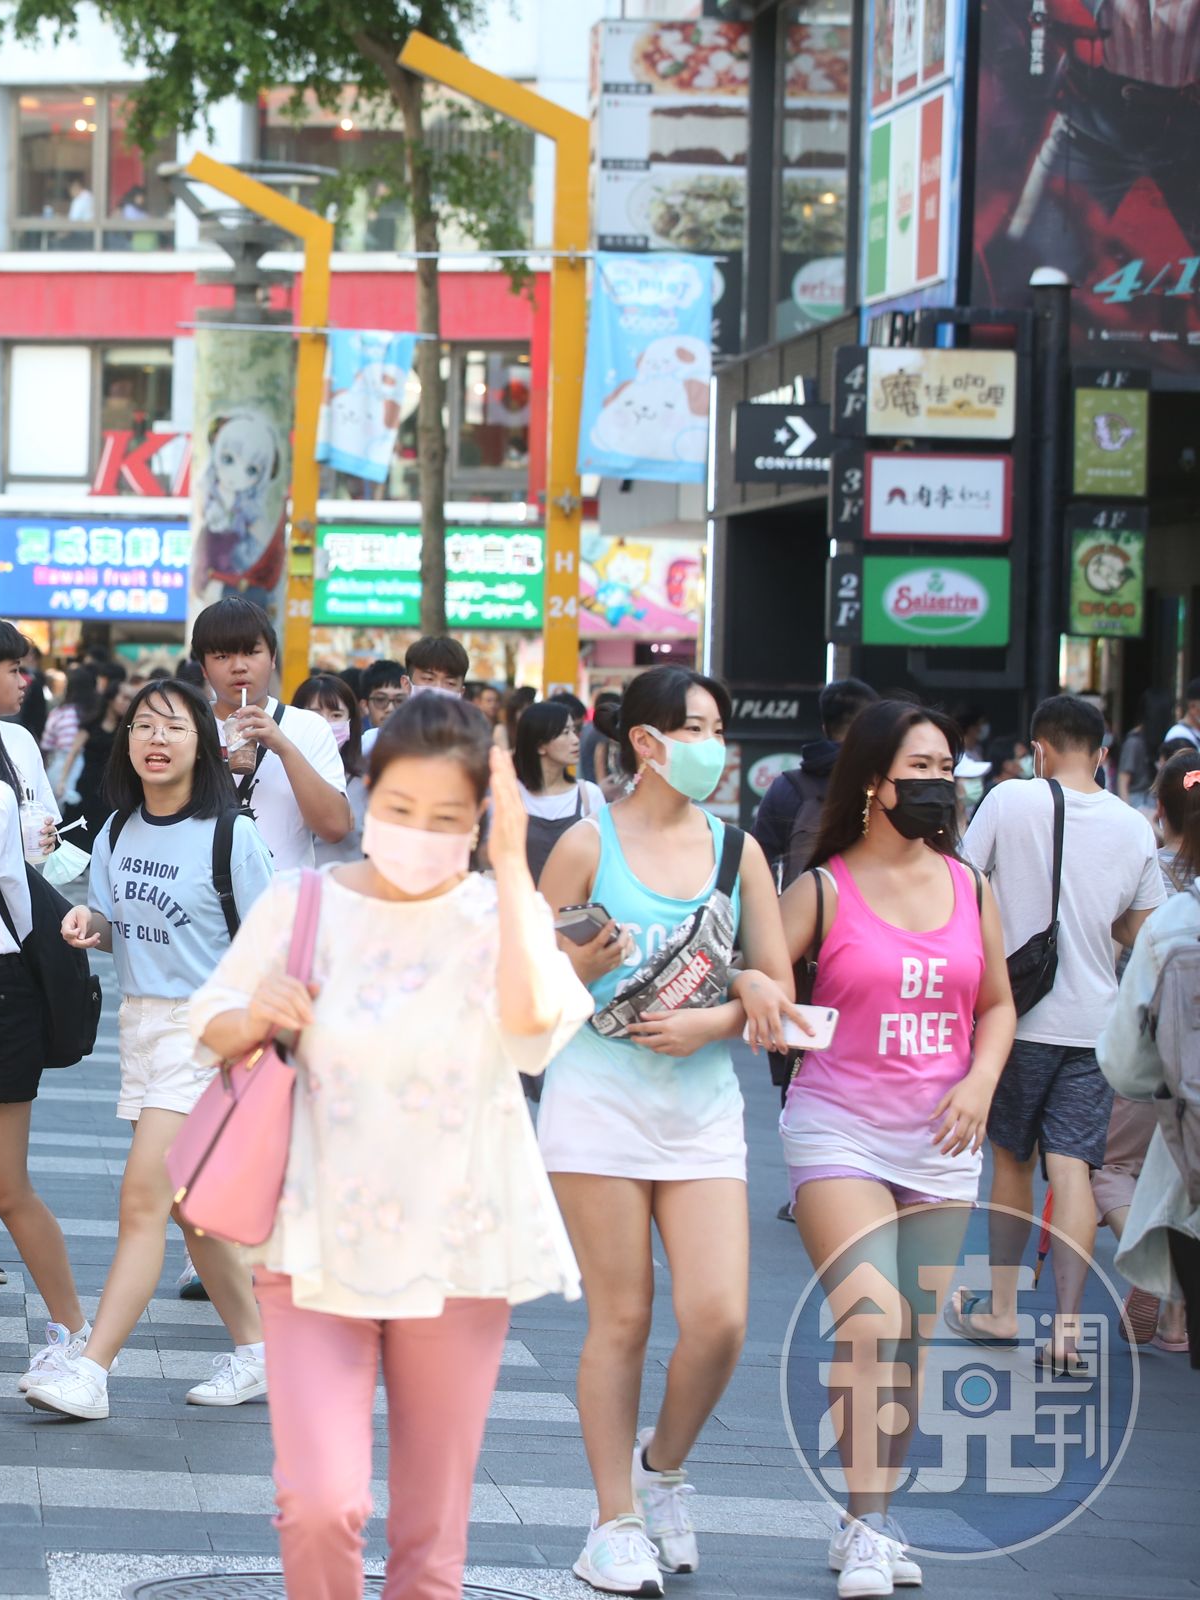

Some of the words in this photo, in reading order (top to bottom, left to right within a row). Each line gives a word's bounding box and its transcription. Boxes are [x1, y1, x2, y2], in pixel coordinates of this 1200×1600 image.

[555, 550, 574, 574] H
[549, 596, 577, 618] 24
[739, 699, 800, 719] PLAZA
[124, 880, 193, 928] BEAUTY
[136, 924, 171, 945] CLUB
[900, 956, 949, 999] BE
[878, 1011, 959, 1057] FREE
